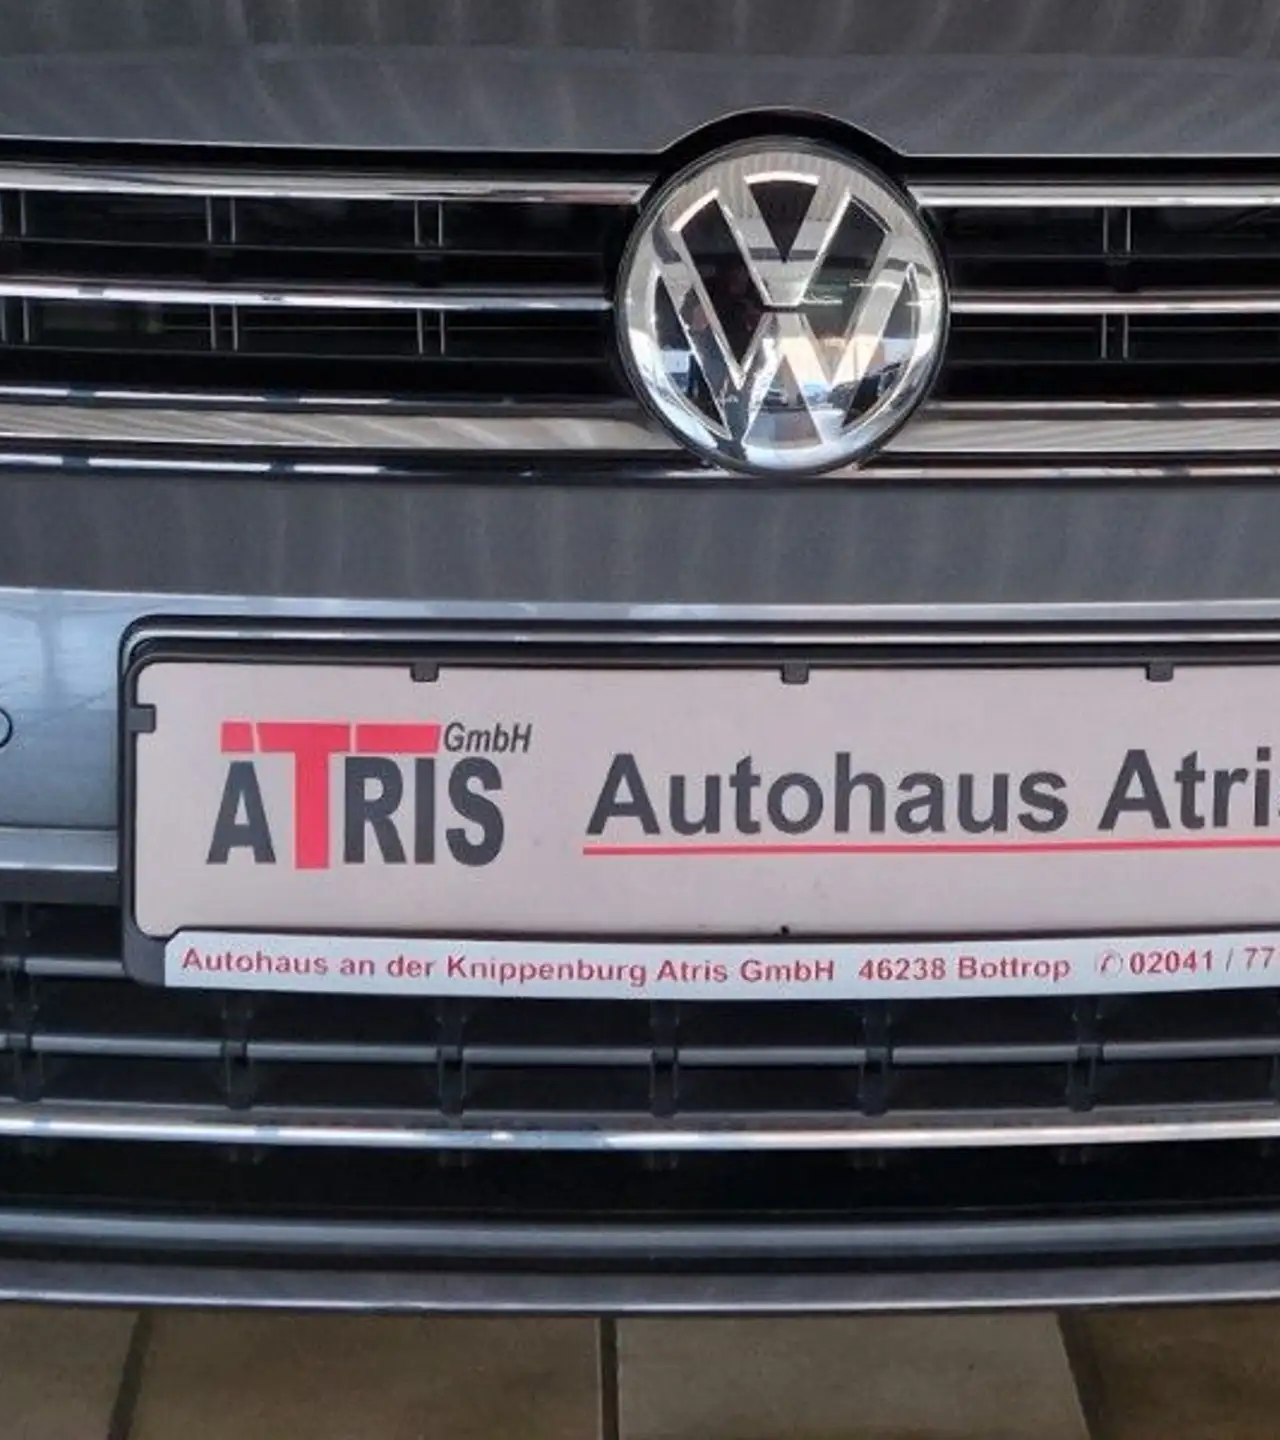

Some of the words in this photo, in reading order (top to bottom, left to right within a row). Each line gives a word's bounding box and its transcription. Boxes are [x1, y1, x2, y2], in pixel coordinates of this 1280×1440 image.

[442, 721, 533, 754] GmbH
[206, 721, 505, 870] ATRIS
[585, 752, 1069, 836] Autohaus
[181, 947, 330, 976] Autohaus
[338, 956, 376, 978] an
[386, 954, 434, 980] der
[446, 954, 648, 987] Knippenburg
[656, 959, 729, 983] Atris
[739, 958, 836, 983] GmbH
[857, 957, 948, 981] 46238
[958, 956, 1072, 984] Bottrop
[1129, 949, 1214, 976] 02041
